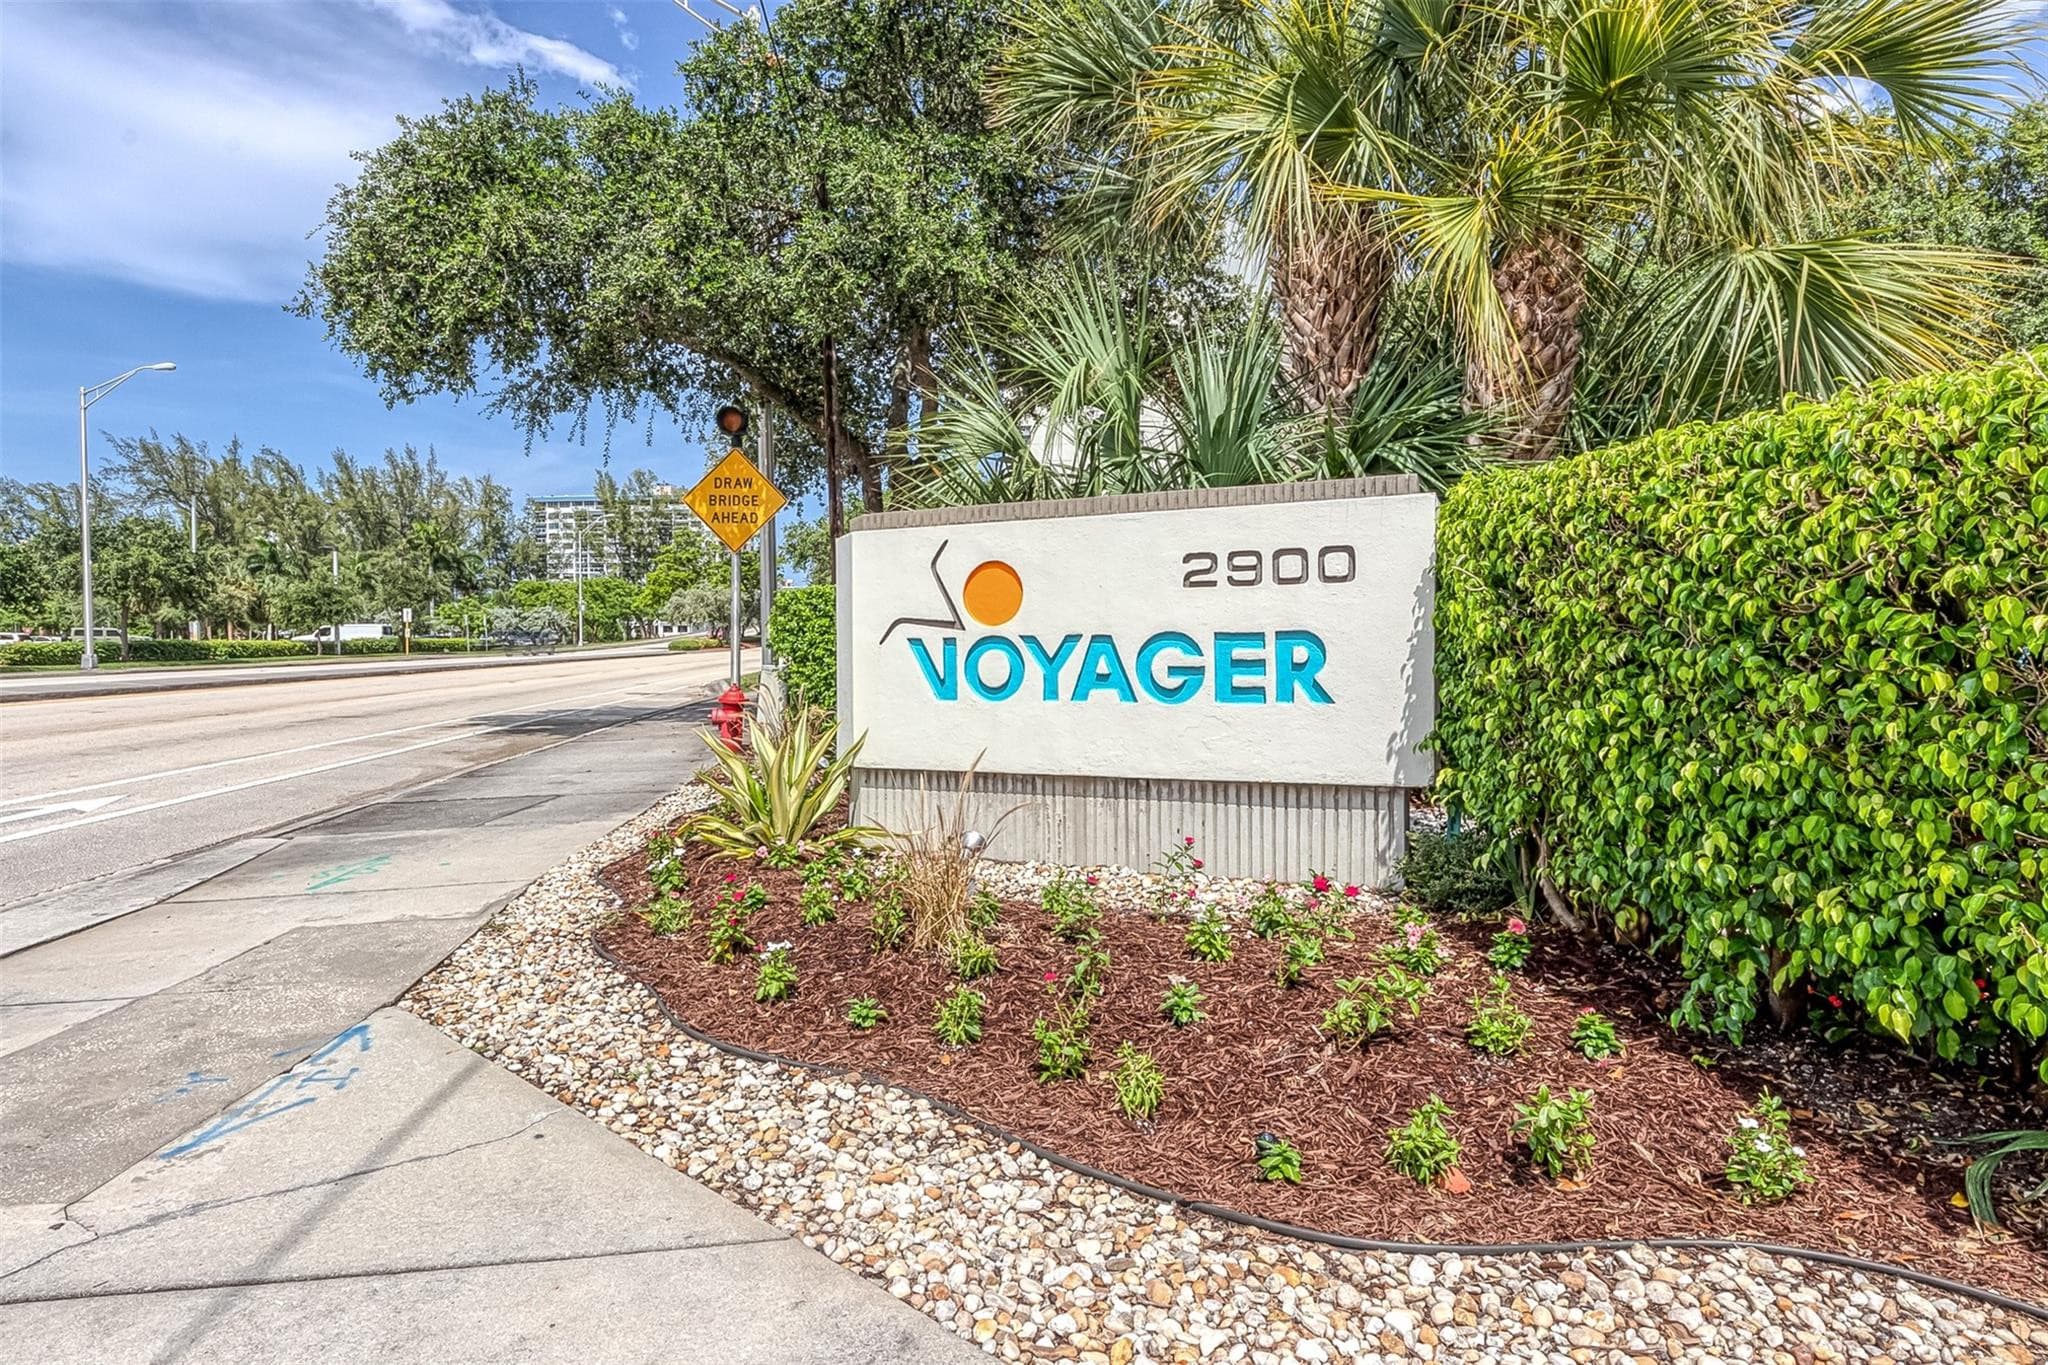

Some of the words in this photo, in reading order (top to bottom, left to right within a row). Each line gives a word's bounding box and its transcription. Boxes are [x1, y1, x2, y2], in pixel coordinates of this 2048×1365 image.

[714, 477, 753, 489] DRAW
[709, 495, 759, 506] BRIDGE
[711, 512, 758, 524] AHEAD
[1183, 545, 1356, 588] 2900
[908, 630, 1335, 704] VOYAGER
